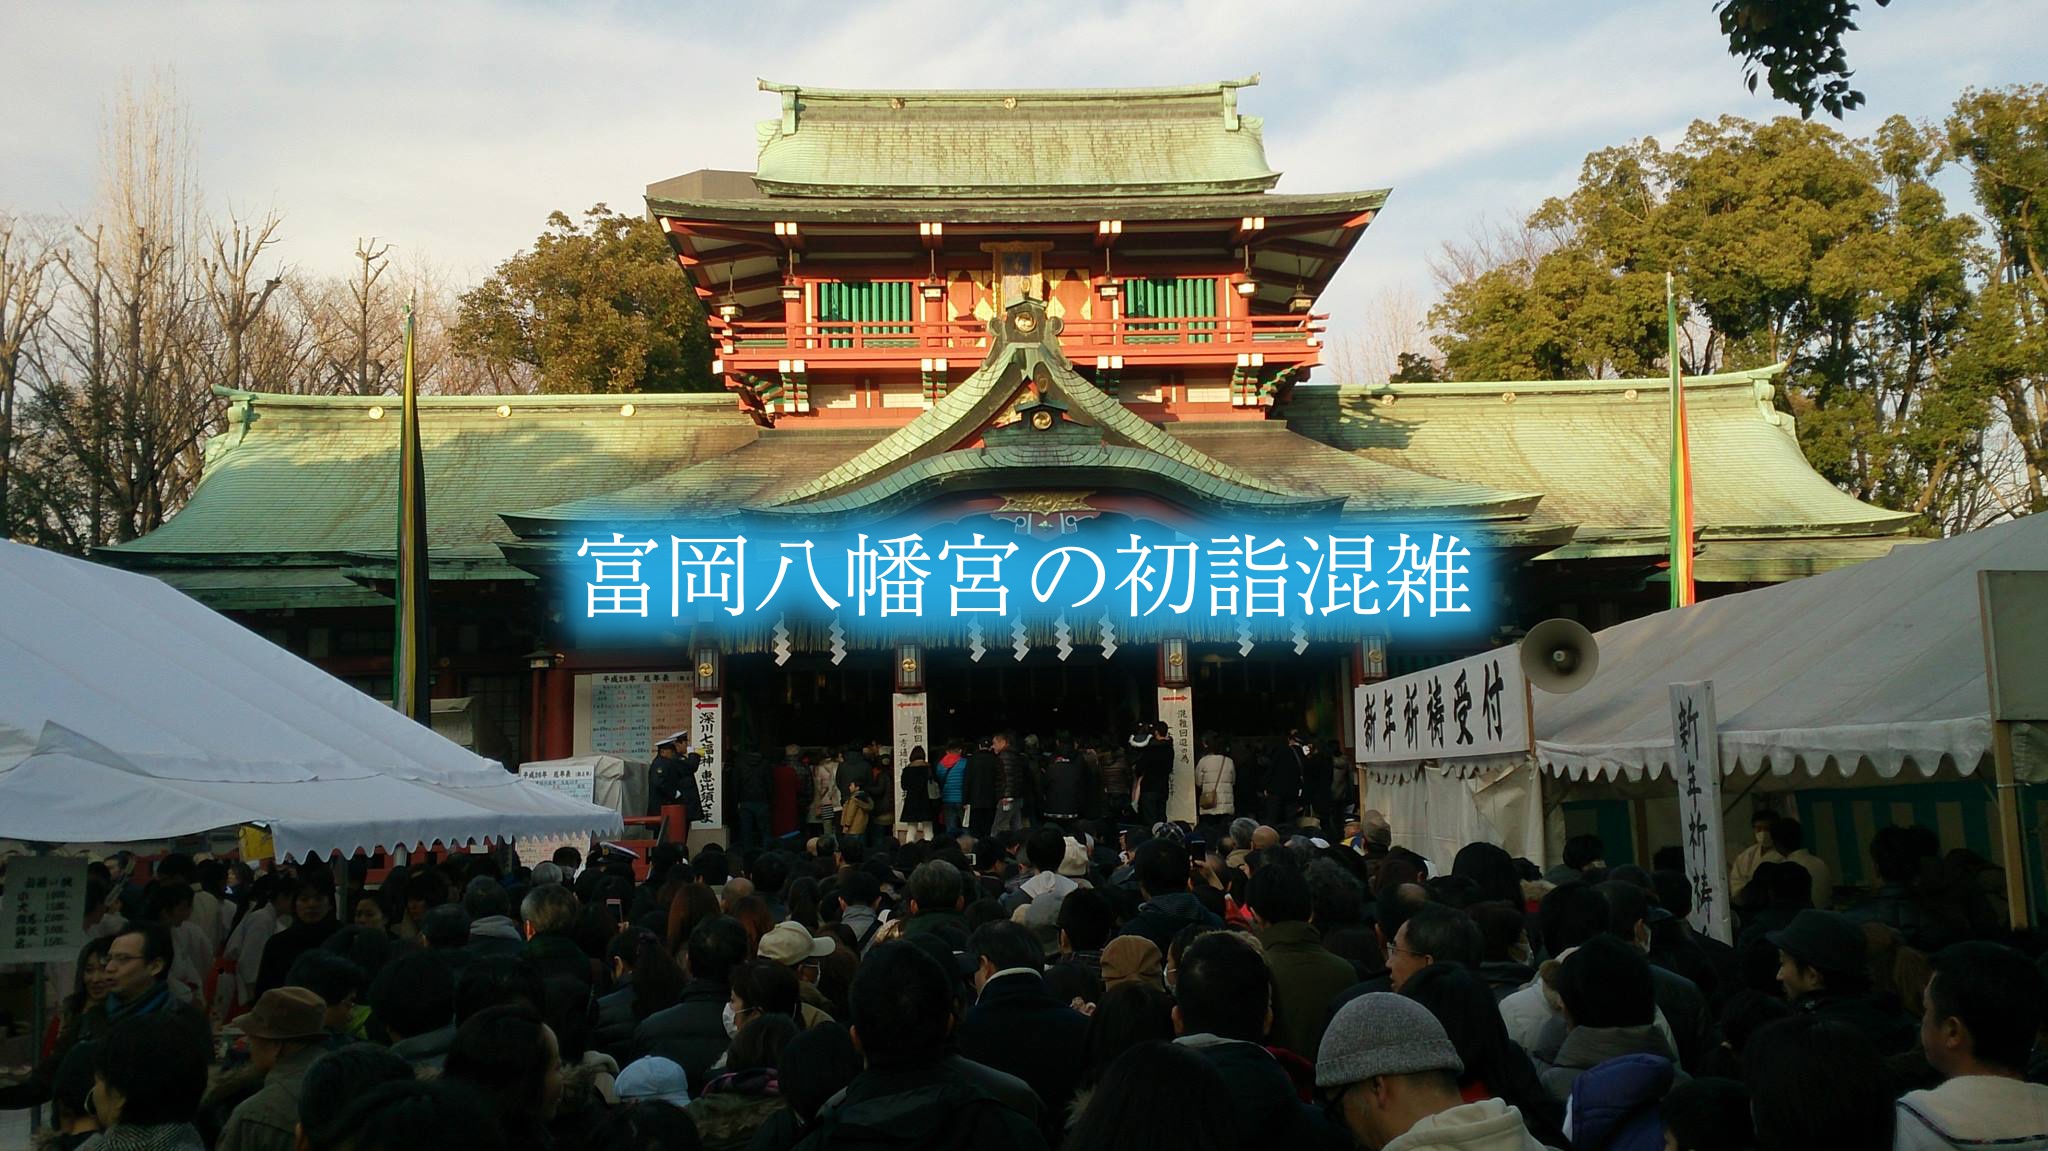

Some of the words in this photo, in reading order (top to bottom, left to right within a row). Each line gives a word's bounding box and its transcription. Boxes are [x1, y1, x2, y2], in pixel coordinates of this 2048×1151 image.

[699, 712, 715, 768] 深川七福神
